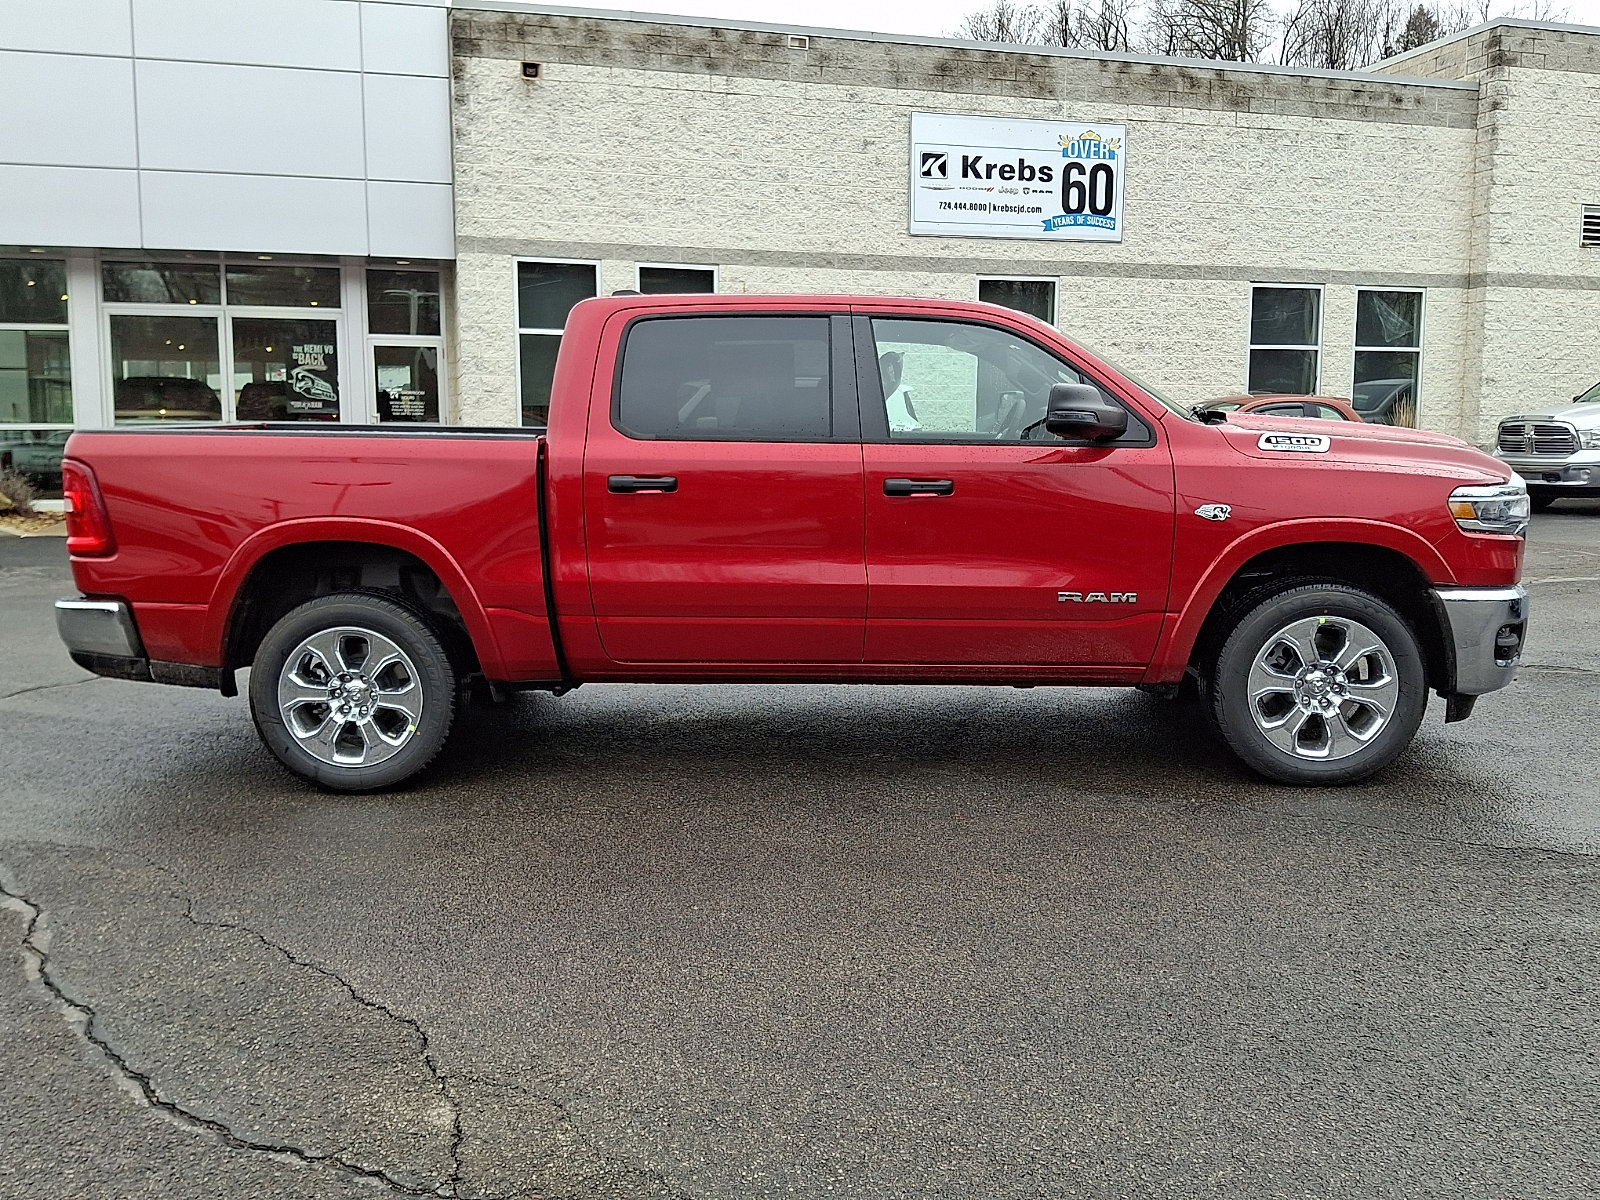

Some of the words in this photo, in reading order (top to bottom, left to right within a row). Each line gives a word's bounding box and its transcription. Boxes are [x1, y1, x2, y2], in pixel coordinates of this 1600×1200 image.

[1067, 140, 1110, 159] OVER
[961, 154, 1053, 183] Krebs
[998, 186, 1019, 195] Jeep
[1061, 161, 1114, 216] 60
[939, 201, 987, 212] 724.444.8000
[992, 203, 1042, 214] krebscjd.com
[1053, 216, 1075, 227] YEARS
[1076, 216, 1086, 225] OF
[1086, 216, 1115, 229] SUCCESS
[303, 344, 323, 354] HEMI
[323, 344, 334, 355] V8
[298, 352, 325, 366] BACK
[1269, 436, 1321, 446] 1500
[1057, 591, 1138, 603] RAM
